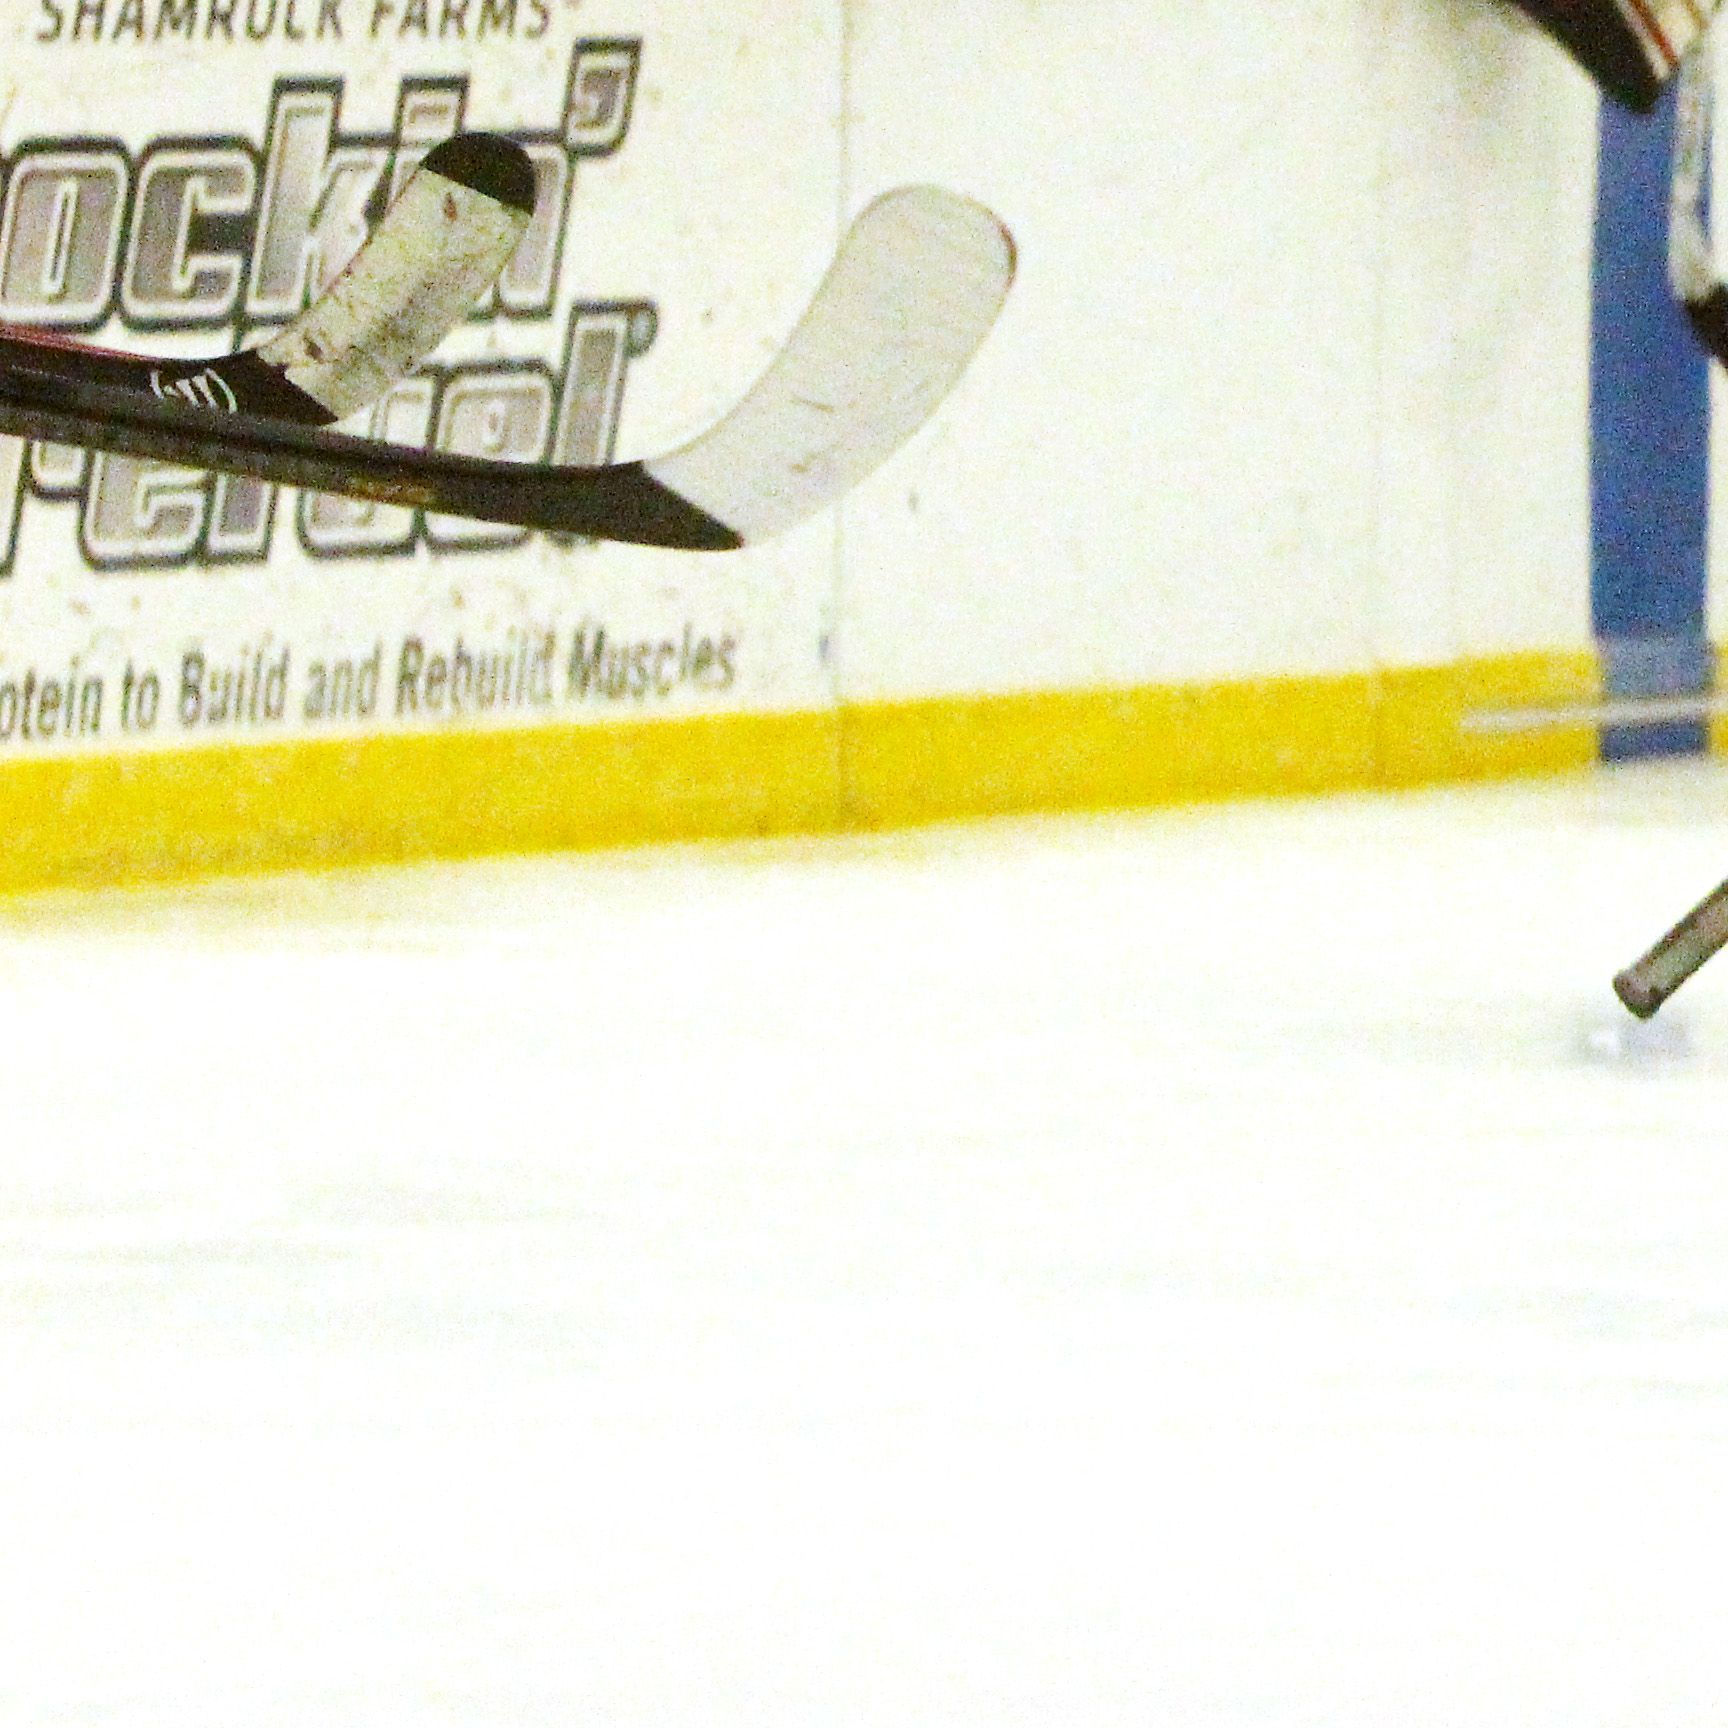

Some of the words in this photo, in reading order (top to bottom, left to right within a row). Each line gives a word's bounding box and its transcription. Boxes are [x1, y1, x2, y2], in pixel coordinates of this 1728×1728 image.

[120, 660, 161, 731] to
[177, 640, 291, 729] Build
[302, 640, 383, 721] and
[396, 624, 556, 716] Rebuild
[565, 619, 738, 702] Muscles
